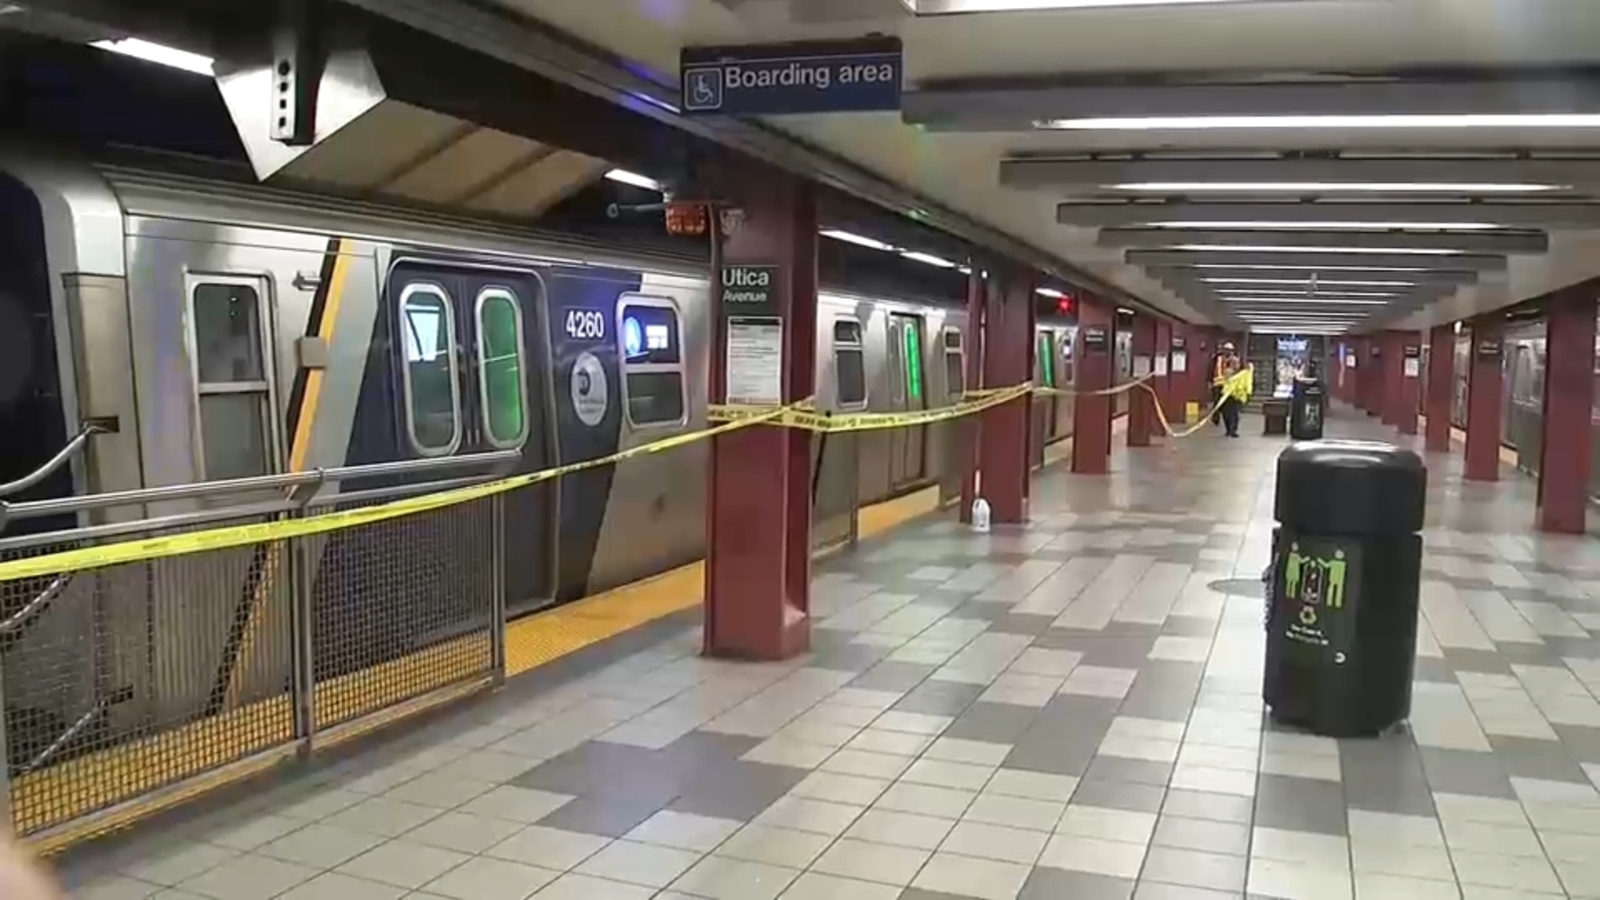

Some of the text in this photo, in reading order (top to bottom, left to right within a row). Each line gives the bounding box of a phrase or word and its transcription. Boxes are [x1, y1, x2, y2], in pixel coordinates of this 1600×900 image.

[725, 63, 893, 88] Boarding area
[722, 268, 769, 286] Utica
[722, 290, 767, 302] Avenue
[566, 310, 604, 338] 4260
